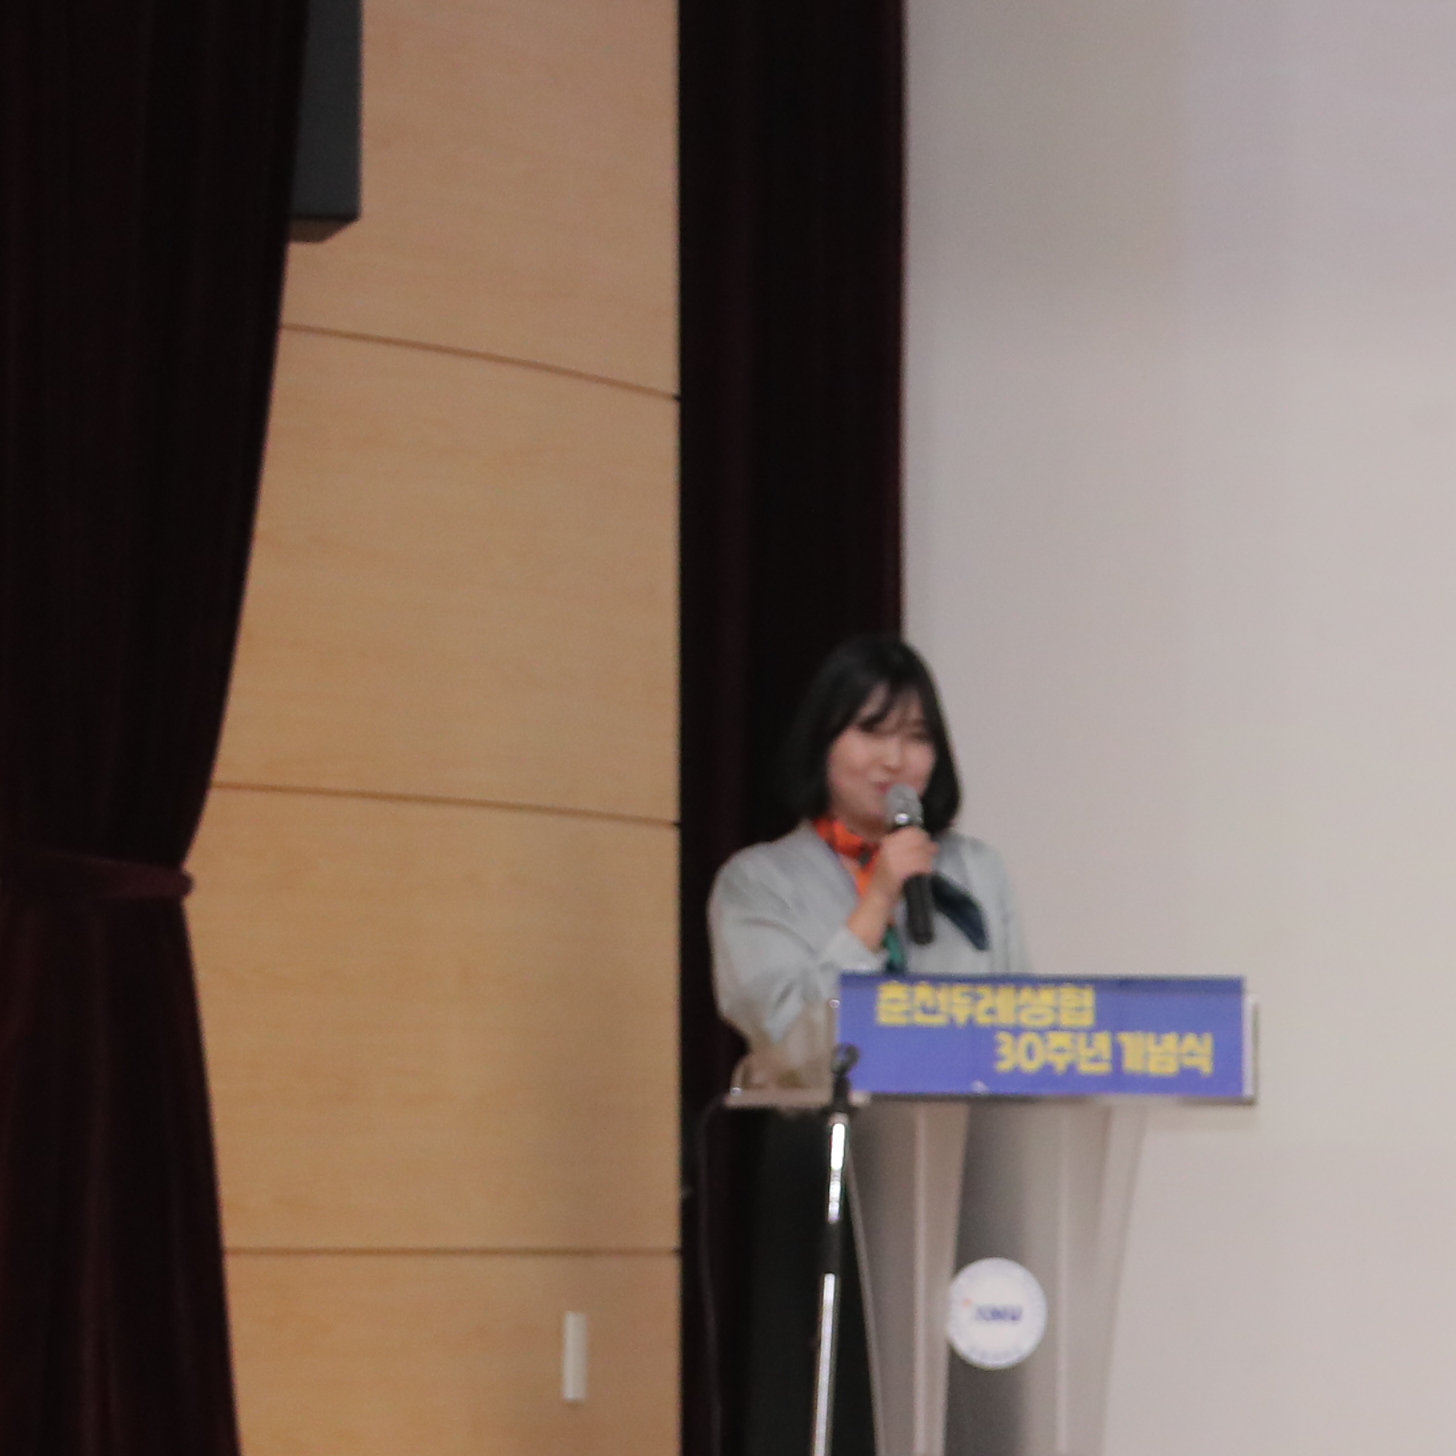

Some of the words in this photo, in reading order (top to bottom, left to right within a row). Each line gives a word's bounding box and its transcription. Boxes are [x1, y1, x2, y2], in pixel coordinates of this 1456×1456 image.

[876, 980, 1095, 1027] 춘천두레생협
[995, 1031, 1112, 1075] 30주년
[1117, 1032, 1214, 1077] 기념식
